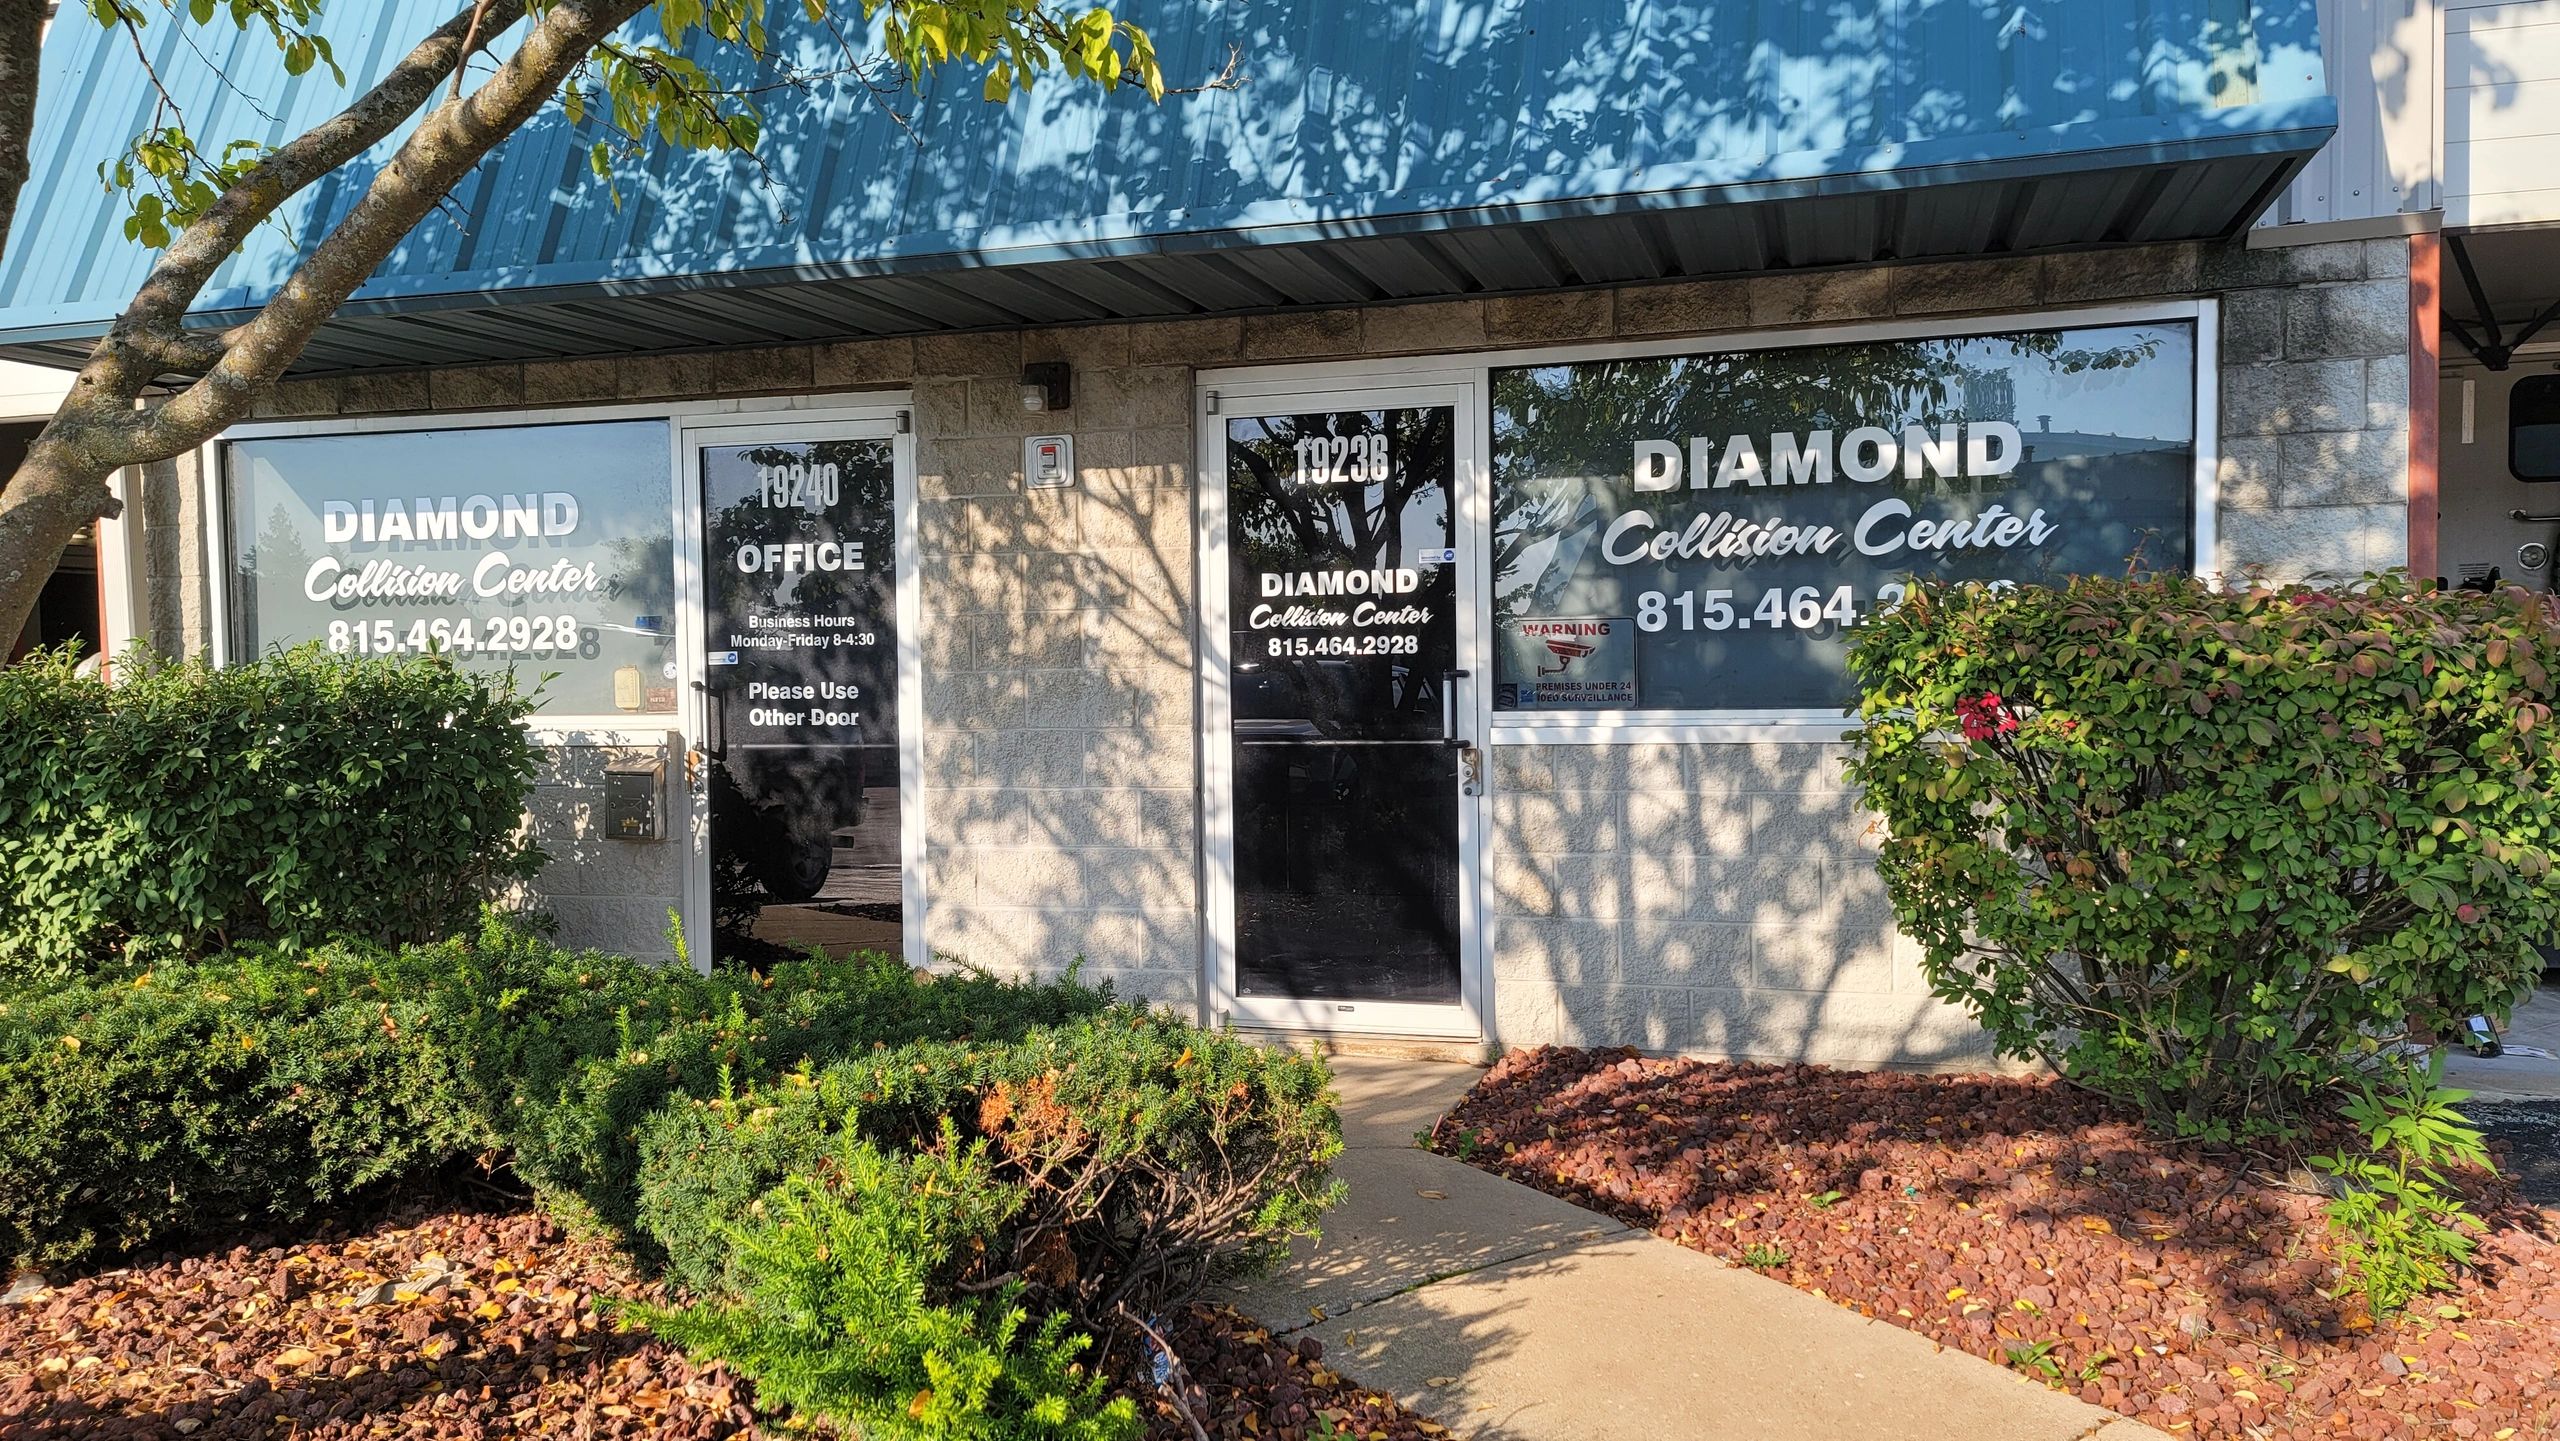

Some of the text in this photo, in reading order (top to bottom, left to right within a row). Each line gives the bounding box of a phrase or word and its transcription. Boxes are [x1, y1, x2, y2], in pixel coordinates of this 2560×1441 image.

[1293, 434, 1388, 485] 19236
[1633, 421, 2023, 492] DIAMOND
[757, 463, 840, 508] 19240
[323, 491, 580, 543] DIAMOND
[1601, 498, 2059, 565] Collision Center
[736, 541, 865, 573] OFFICE
[304, 551, 602, 602] Collision Center
[1261, 568, 1418, 597] DIAMOND
[749, 614, 855, 628] Business Hours
[1249, 601, 1434, 629] Collision Center
[1522, 623, 1611, 636] WARNING
[328, 614, 578, 653] 815.464.2928
[730, 632, 875, 650] Monday-Friday 8-4:30
[1268, 636, 1418, 656] 815.464.2928
[749, 681, 859, 700] Please Use
[1536, 682, 1632, 691] PREMISES UNDER 24
[749, 708, 859, 726] Other Door
